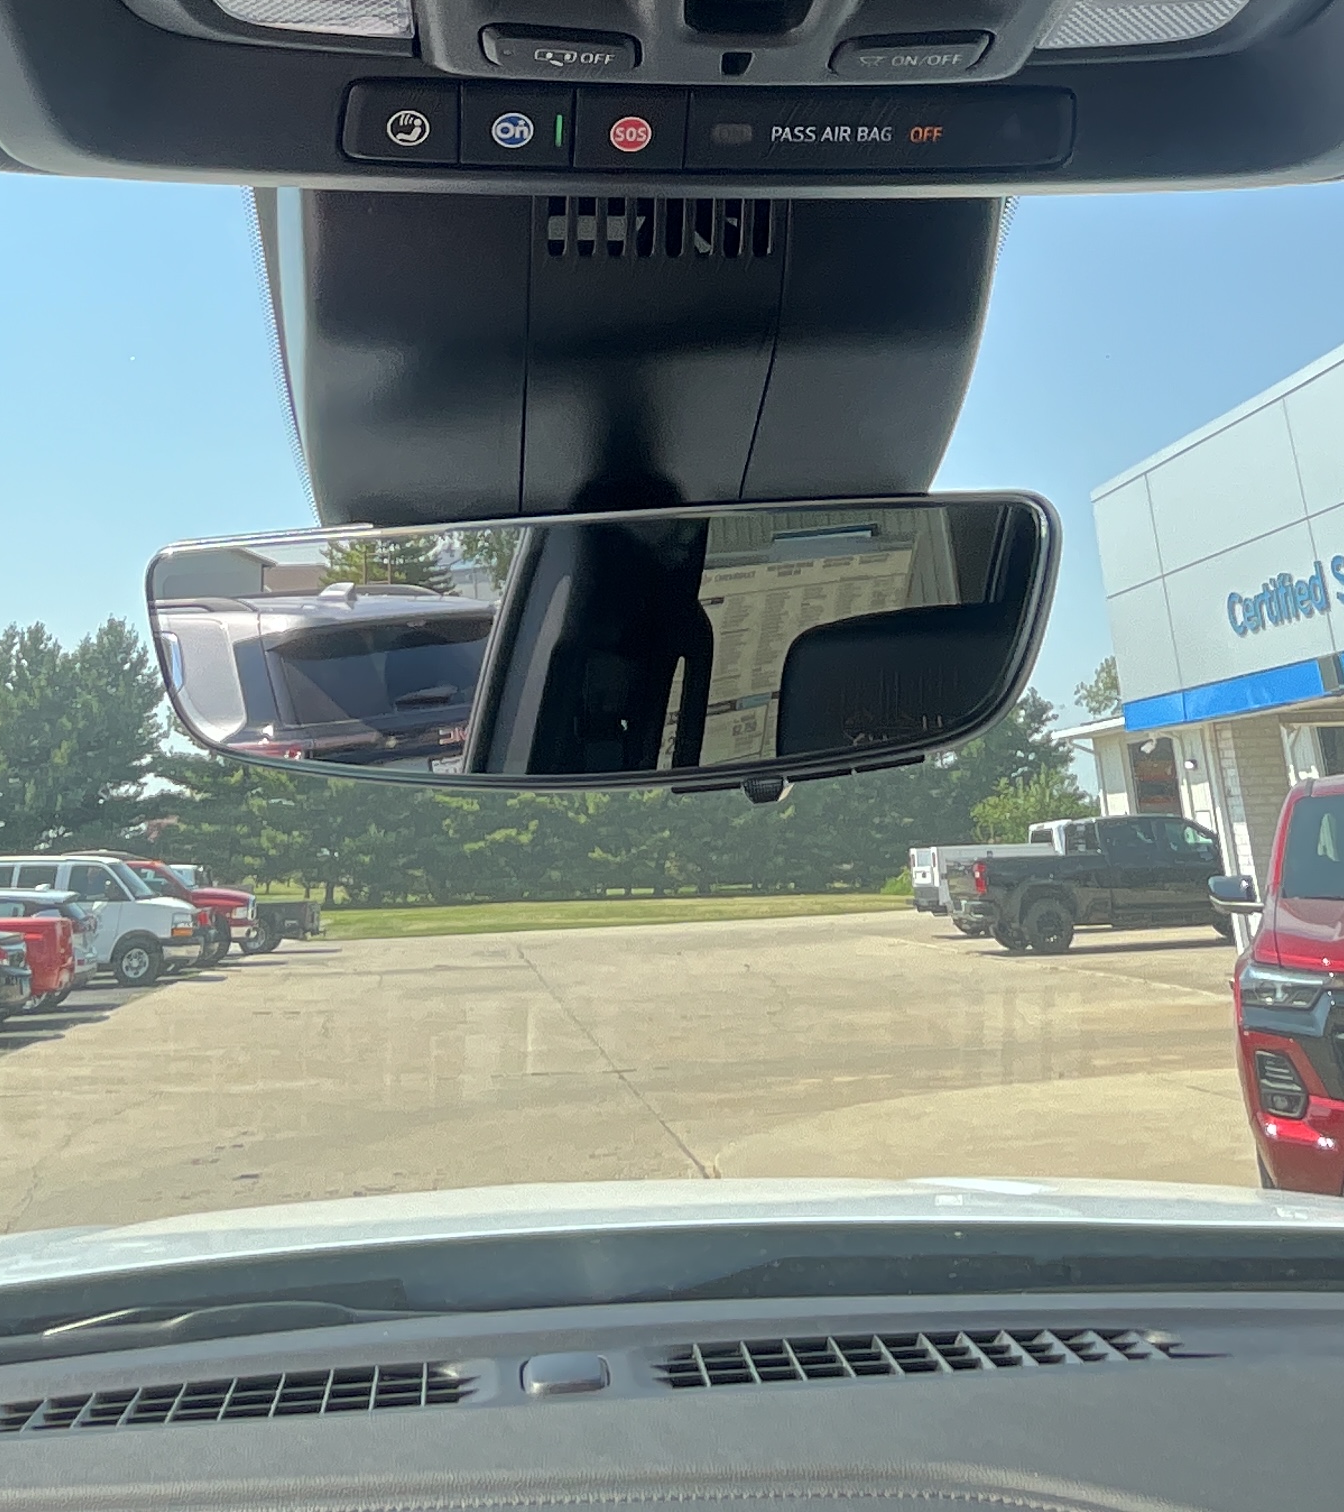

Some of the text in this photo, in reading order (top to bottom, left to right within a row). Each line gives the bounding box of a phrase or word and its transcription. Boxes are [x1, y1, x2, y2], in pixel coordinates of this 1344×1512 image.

[580, 52, 616, 65] OFF
[891, 54, 963, 67] ON/OFF
[615, 127, 647, 142] SOS
[771, 126, 816, 142] PASS
[820, 126, 851, 142] AIR
[857, 126, 893, 142] BAG
[910, 126, 943, 143] OFF
[1227, 560, 1331, 638] Certified
